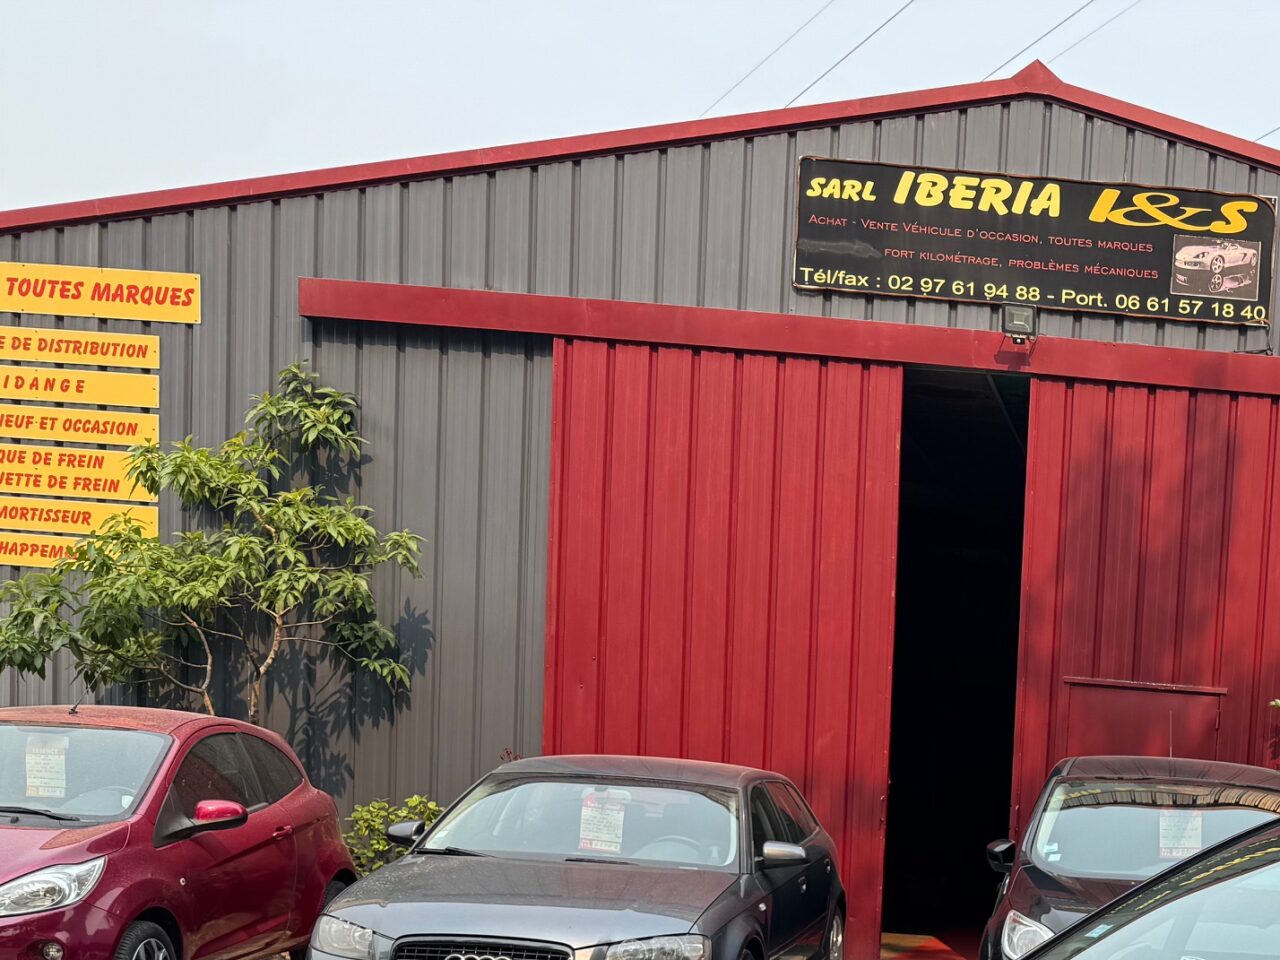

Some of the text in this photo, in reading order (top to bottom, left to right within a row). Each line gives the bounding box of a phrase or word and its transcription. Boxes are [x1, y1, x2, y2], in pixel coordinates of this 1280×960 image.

[806, 170, 1258, 234] SARL IBERIA I&S
[1048, 235, 1092, 249] TOUTES
[1098, 240, 1153, 253] MARQUES
[884, 248, 915, 260] FORT
[1008, 259, 1079, 273] PROBLÈMES
[1084, 263, 1159, 279] MÉCANIQUES
[6, 277, 195, 307] TOUTES MARQUES
[888, 275, 913, 291] 02
[920, 278, 945, 293] 97
[952, 281, 975, 296] 61
[983, 283, 1008, 298] 94
[1015, 285, 1041, 301] 88
[1061, 289, 1107, 308] Port.
[1115, 294, 1140, 310] 06
[1147, 297, 1169, 312] 61
[1178, 300, 1203, 315] 57
[1211, 302, 1235, 318] 18
[1240, 305, 1266, 320] 40
[11, 336, 32, 351] DE
[37, 338, 148, 359] DISTRIBUTION
[39, 416, 59, 431] ET
[62, 418, 138, 437] OCCASION
[32, 451, 53, 466] DE
[57, 453, 105, 470] FREIN
[47, 474, 68, 490] DE
[73, 477, 120, 493] FREIN
